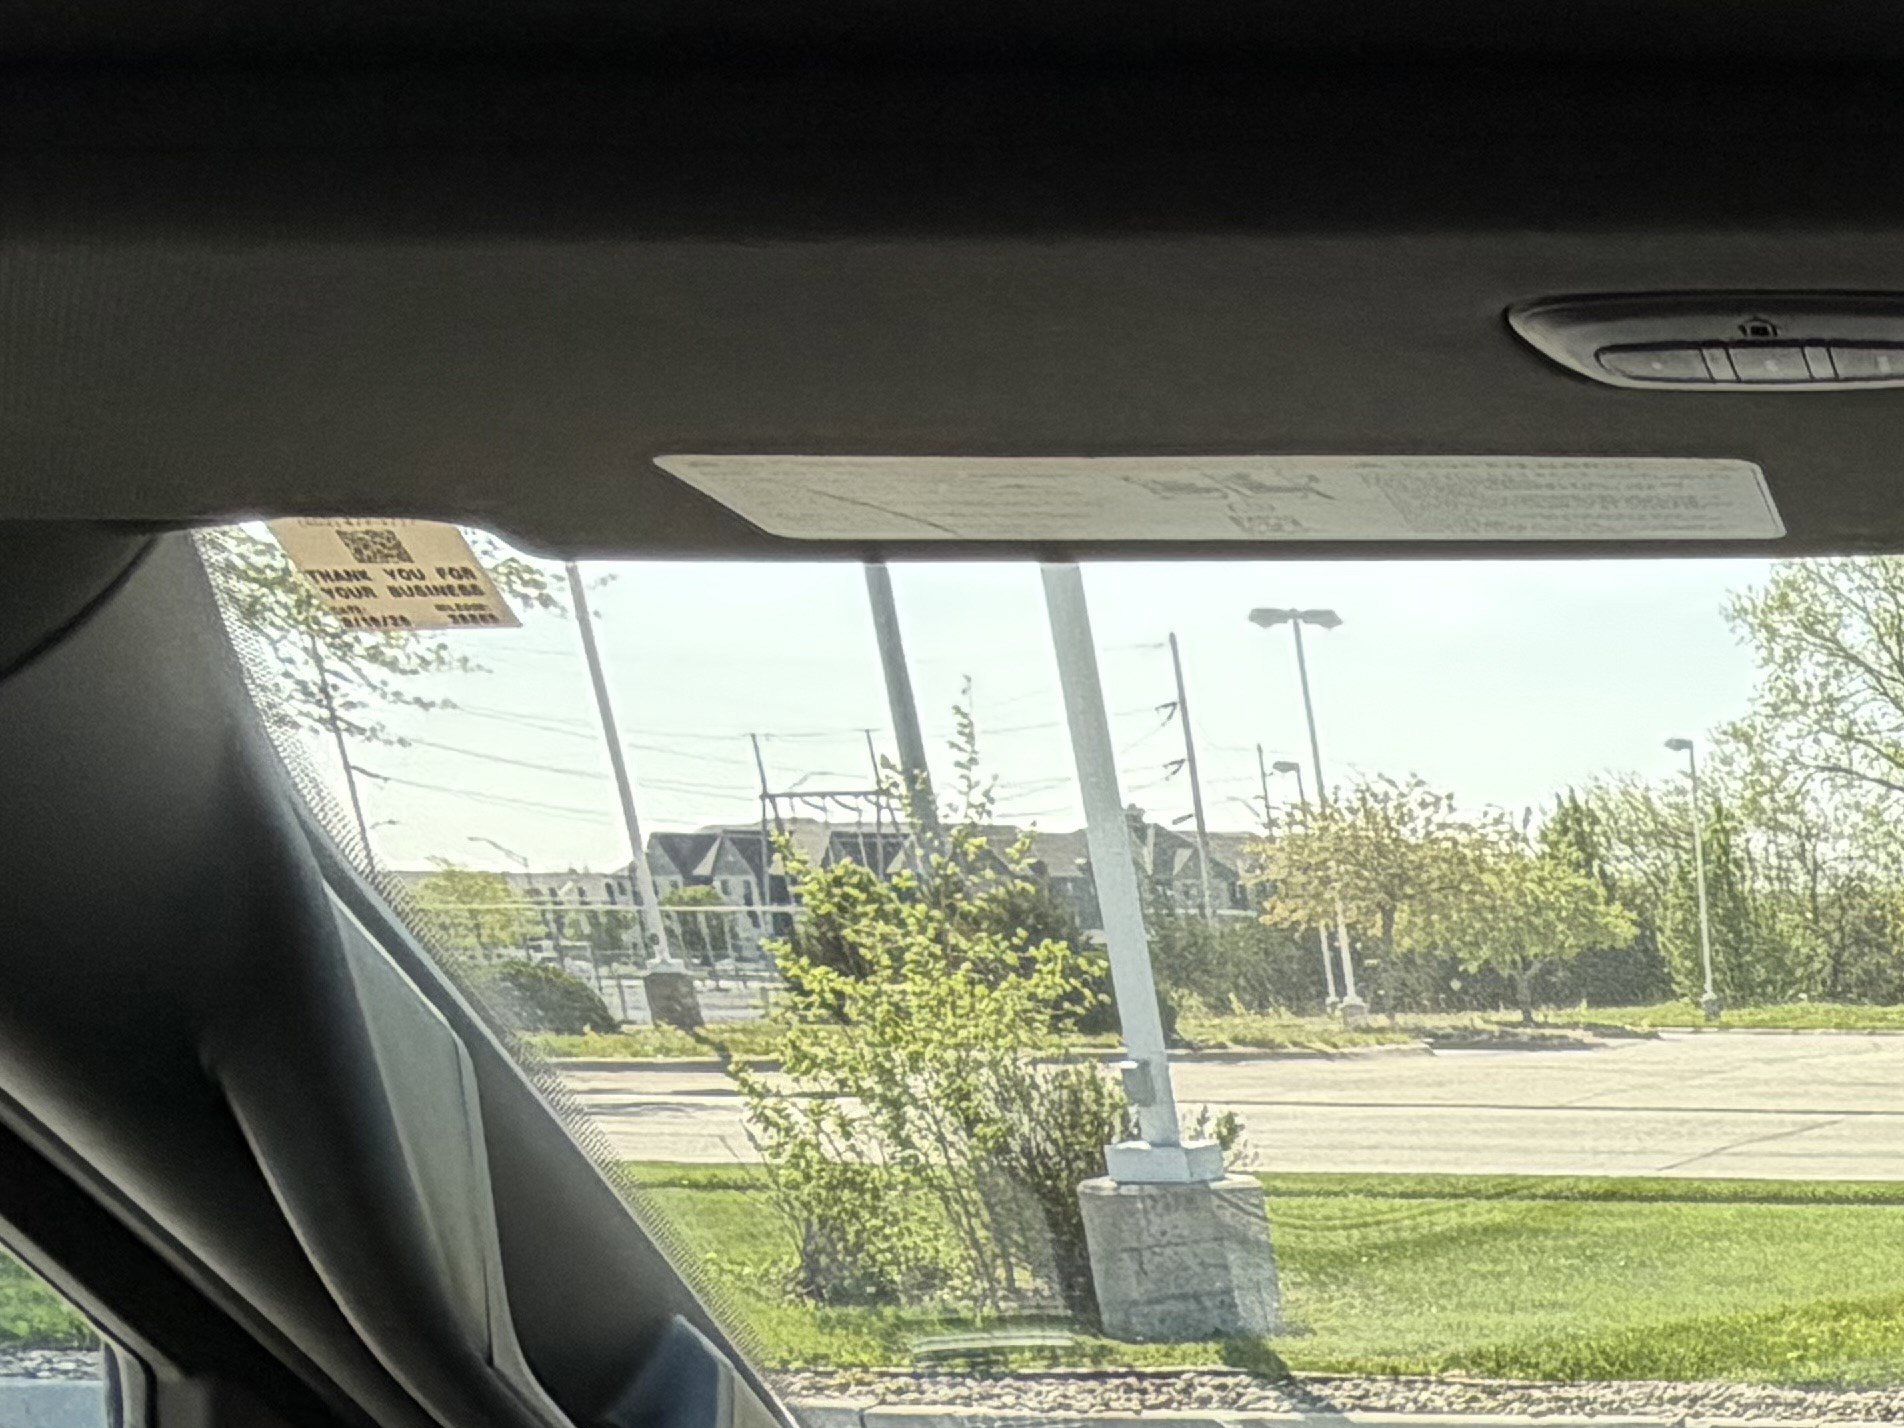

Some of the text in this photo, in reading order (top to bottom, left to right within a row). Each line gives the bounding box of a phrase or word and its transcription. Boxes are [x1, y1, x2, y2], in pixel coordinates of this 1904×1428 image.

[304, 566, 477, 583] THANK YOU FOR
[321, 584, 485, 599] YOUR BUSINESS
